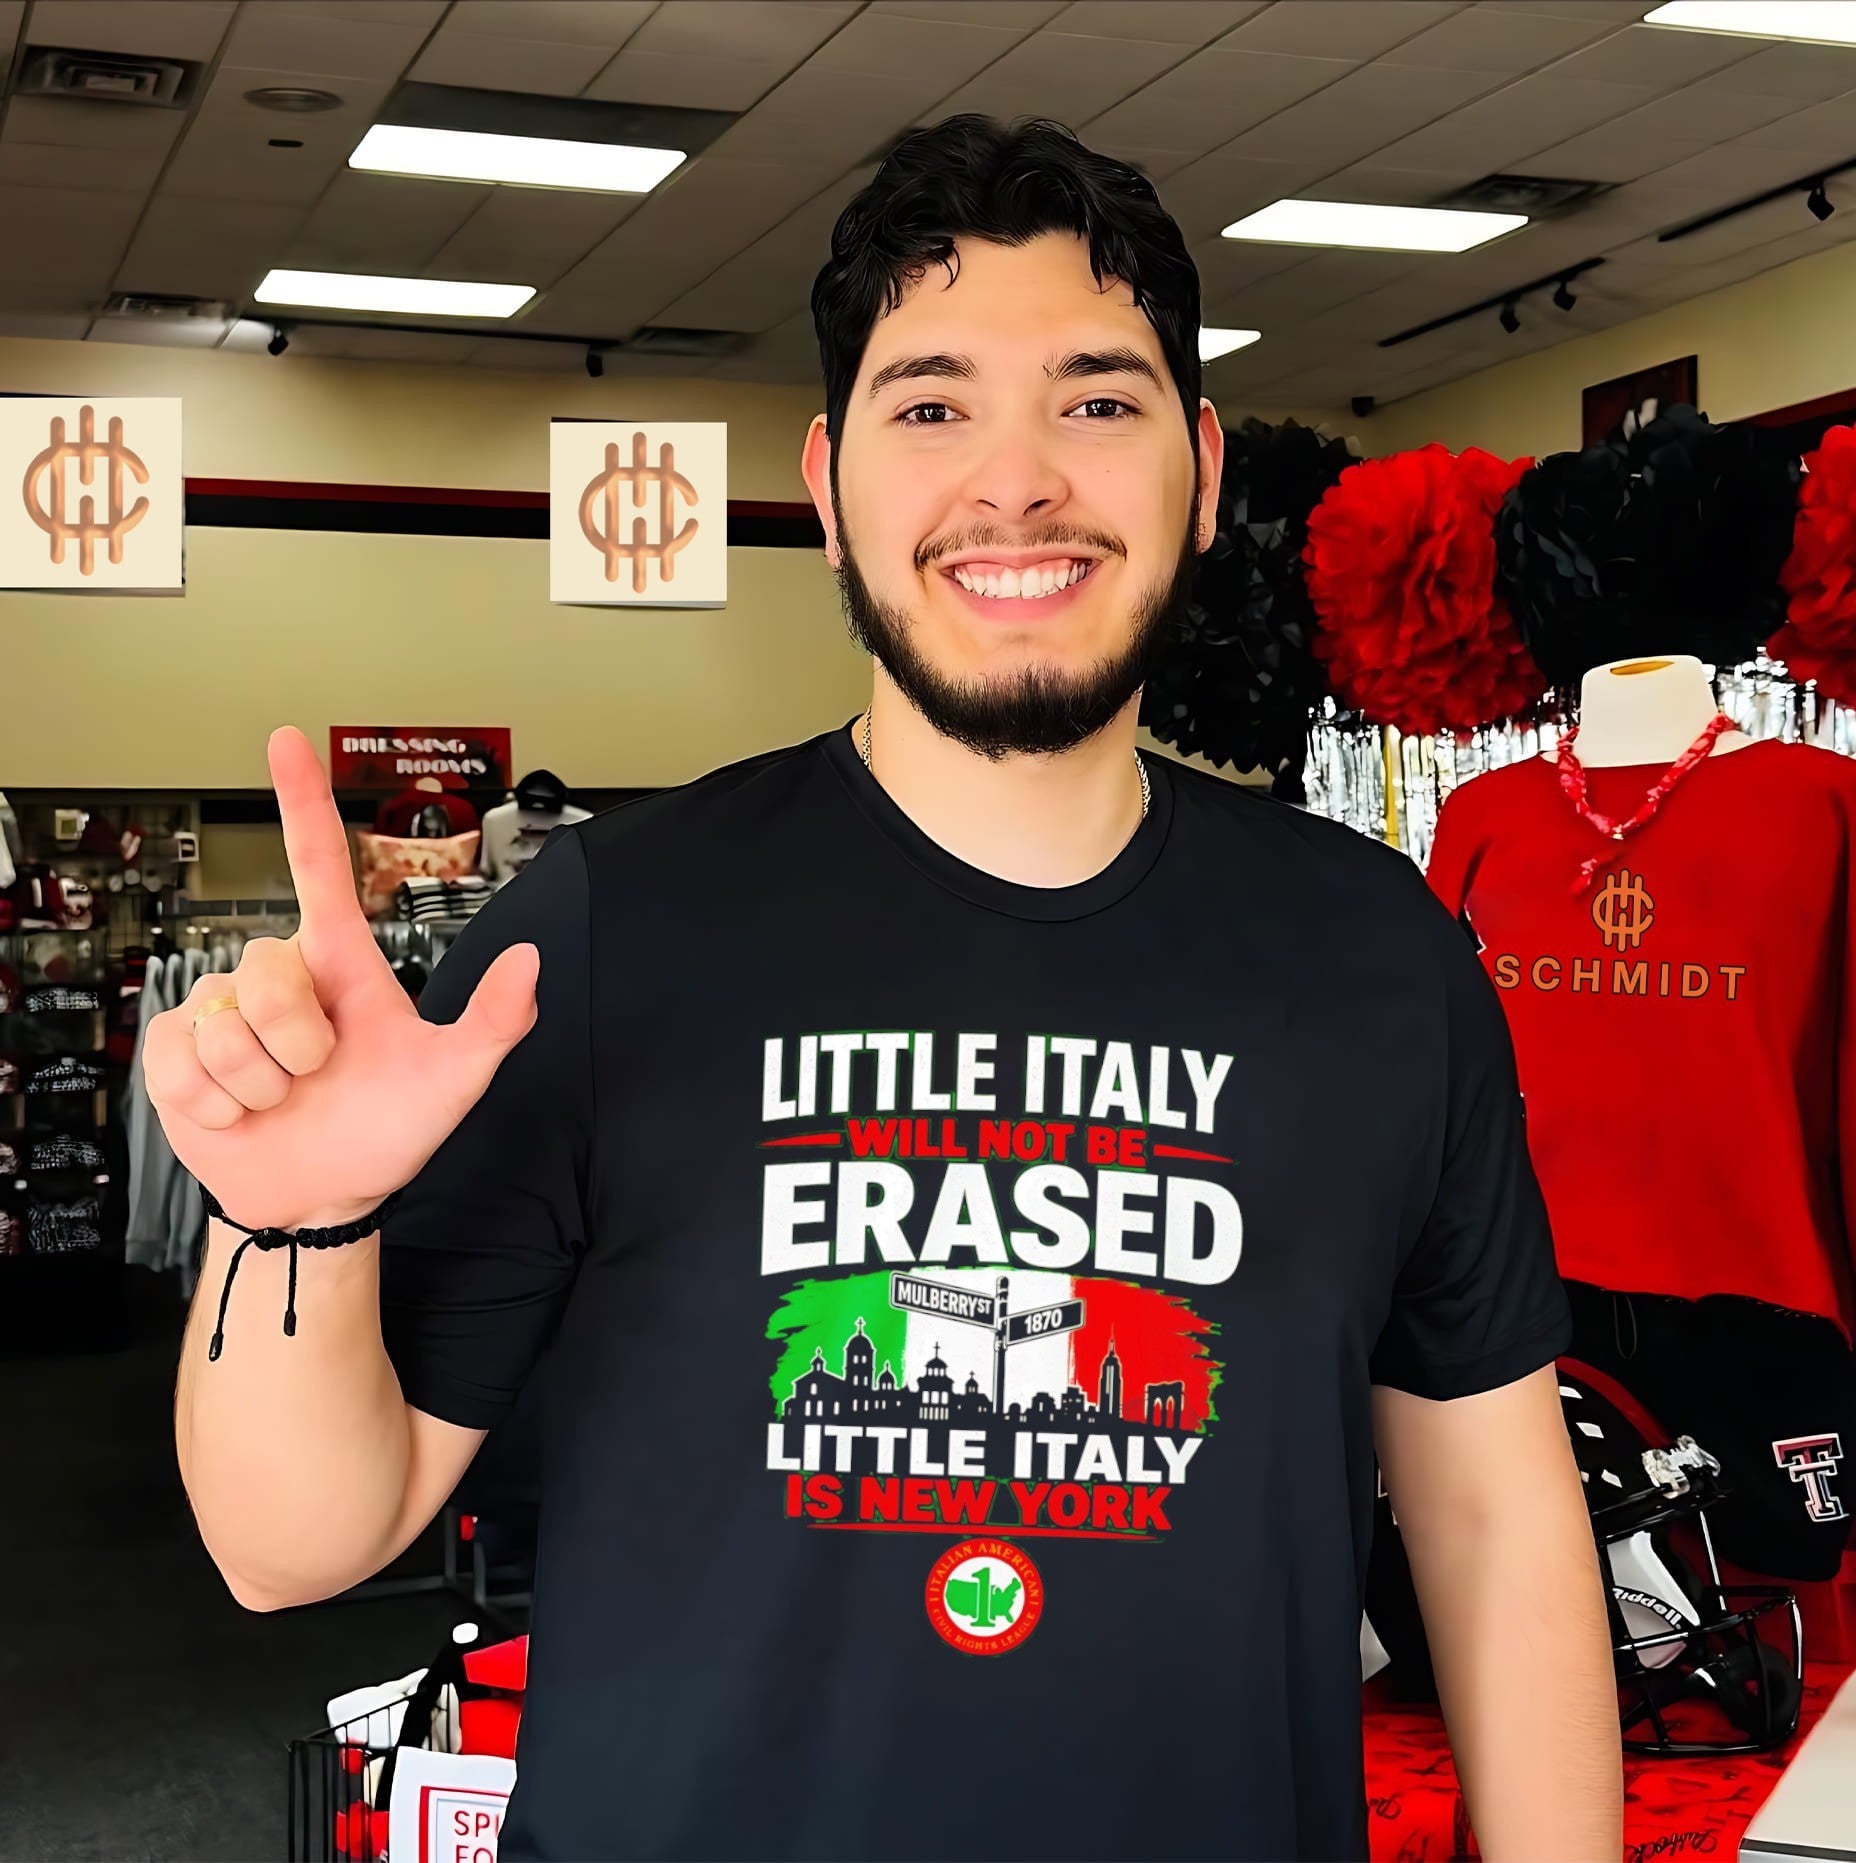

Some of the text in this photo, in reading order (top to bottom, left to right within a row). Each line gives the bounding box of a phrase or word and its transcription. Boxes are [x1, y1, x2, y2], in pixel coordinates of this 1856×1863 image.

[1494, 954, 1747, 1000] SCHMIDT
[761, 1032, 1234, 1134] LITTLE ITALY
[846, 1118, 1147, 1167] WILL NOT BE
[760, 1161, 1244, 1286] ERASED
[1024, 1308, 1063, 1335] 1870
[766, 1422, 1204, 1485] LITTLE ITALY
[786, 1474, 1173, 1531] IS NEW YORK
[930, 1542, 1039, 1598] ITALIAN AMERICAN
[970, 1567, 996, 1628] 1
[954, 1634, 998, 1651] RIGHTS
